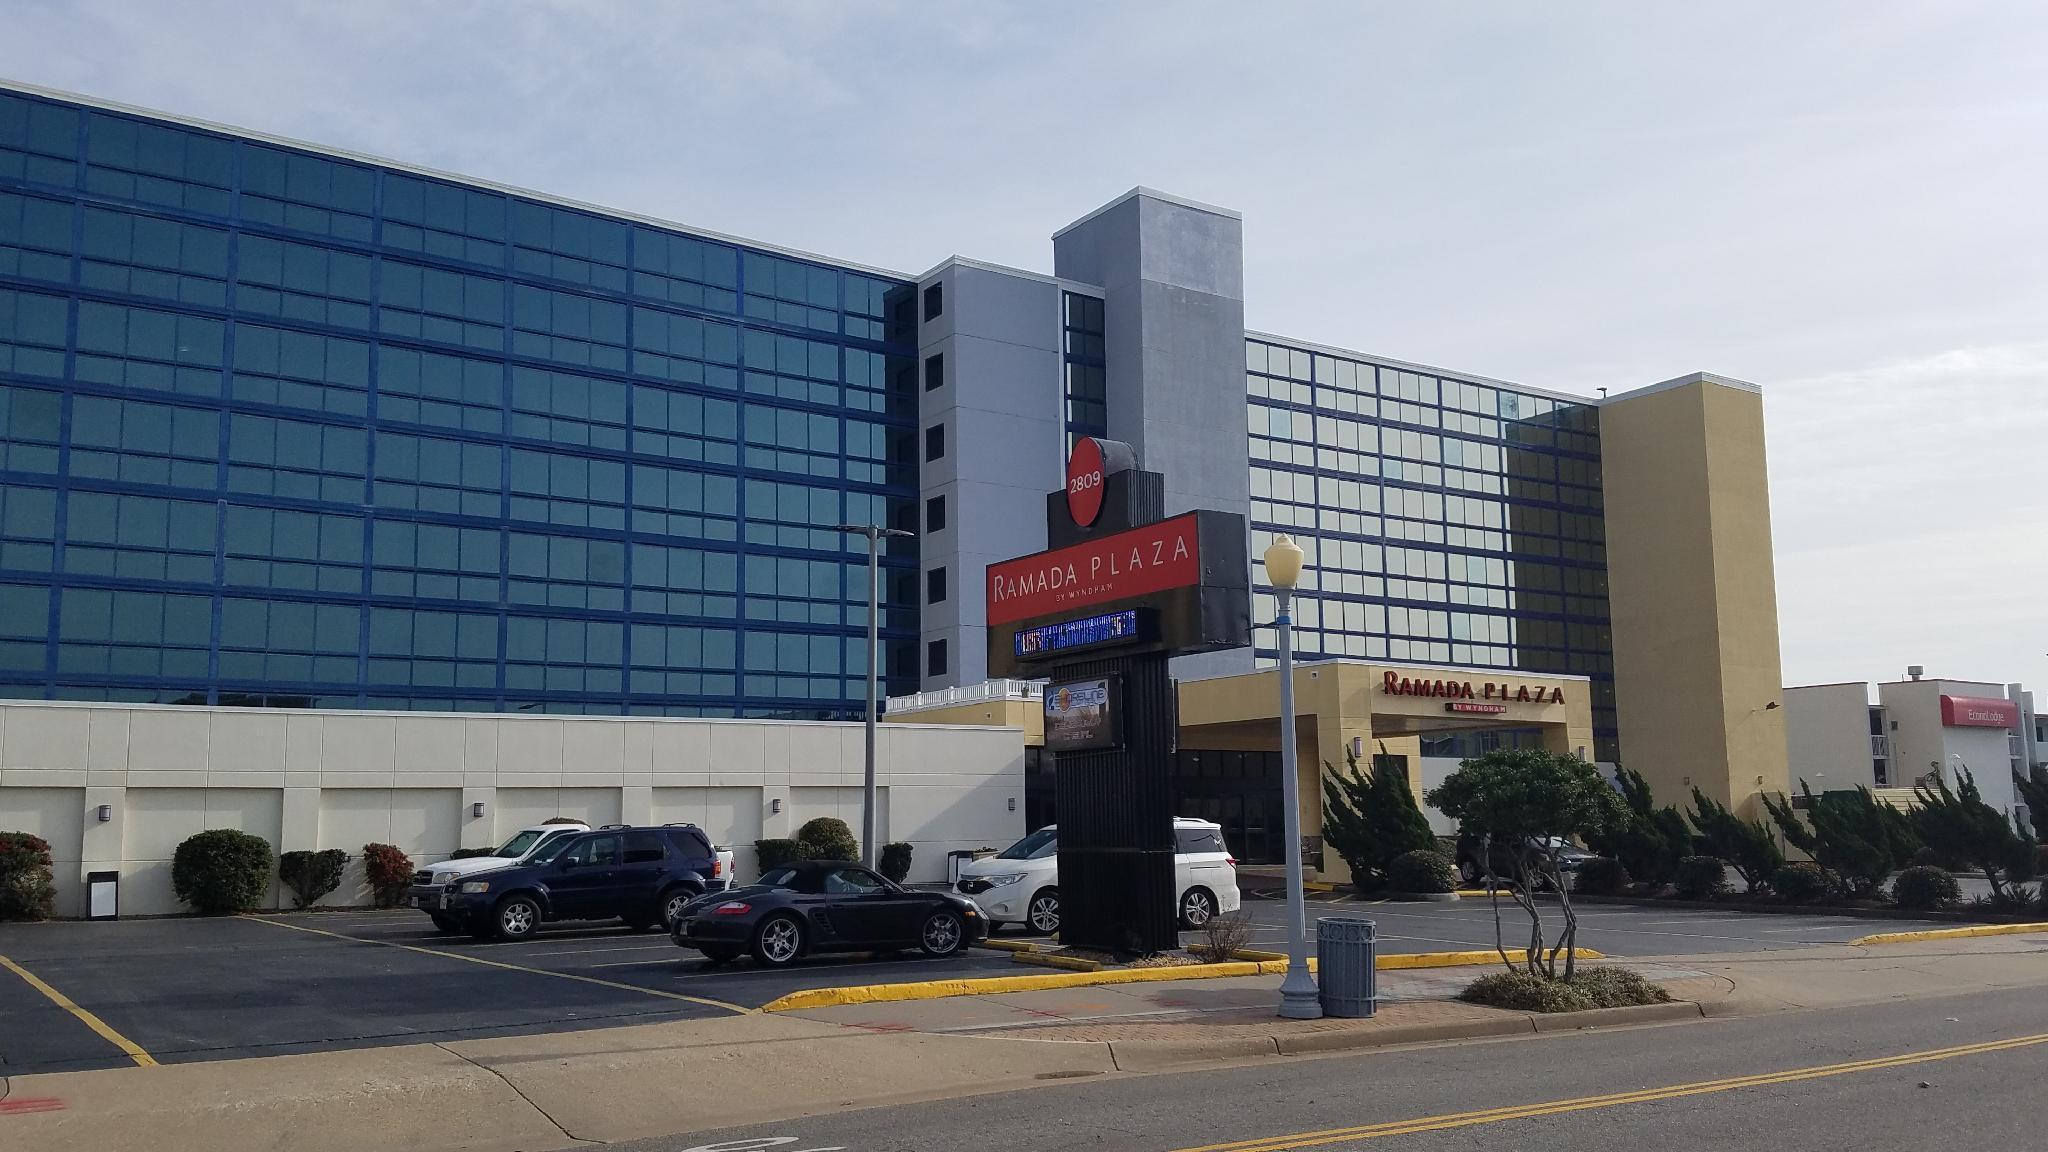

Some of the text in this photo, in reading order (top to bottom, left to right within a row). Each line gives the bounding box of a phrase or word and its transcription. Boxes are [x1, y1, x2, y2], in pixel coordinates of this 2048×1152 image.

[1070, 471, 1101, 494] 2809
[994, 535, 1189, 602] RAMADA PLAZA
[1056, 583, 1114, 602] BY WYNDHAM
[1384, 671, 1566, 705] RAMADA PLAZA
[1453, 703, 1507, 713] BY WYNDHAM
